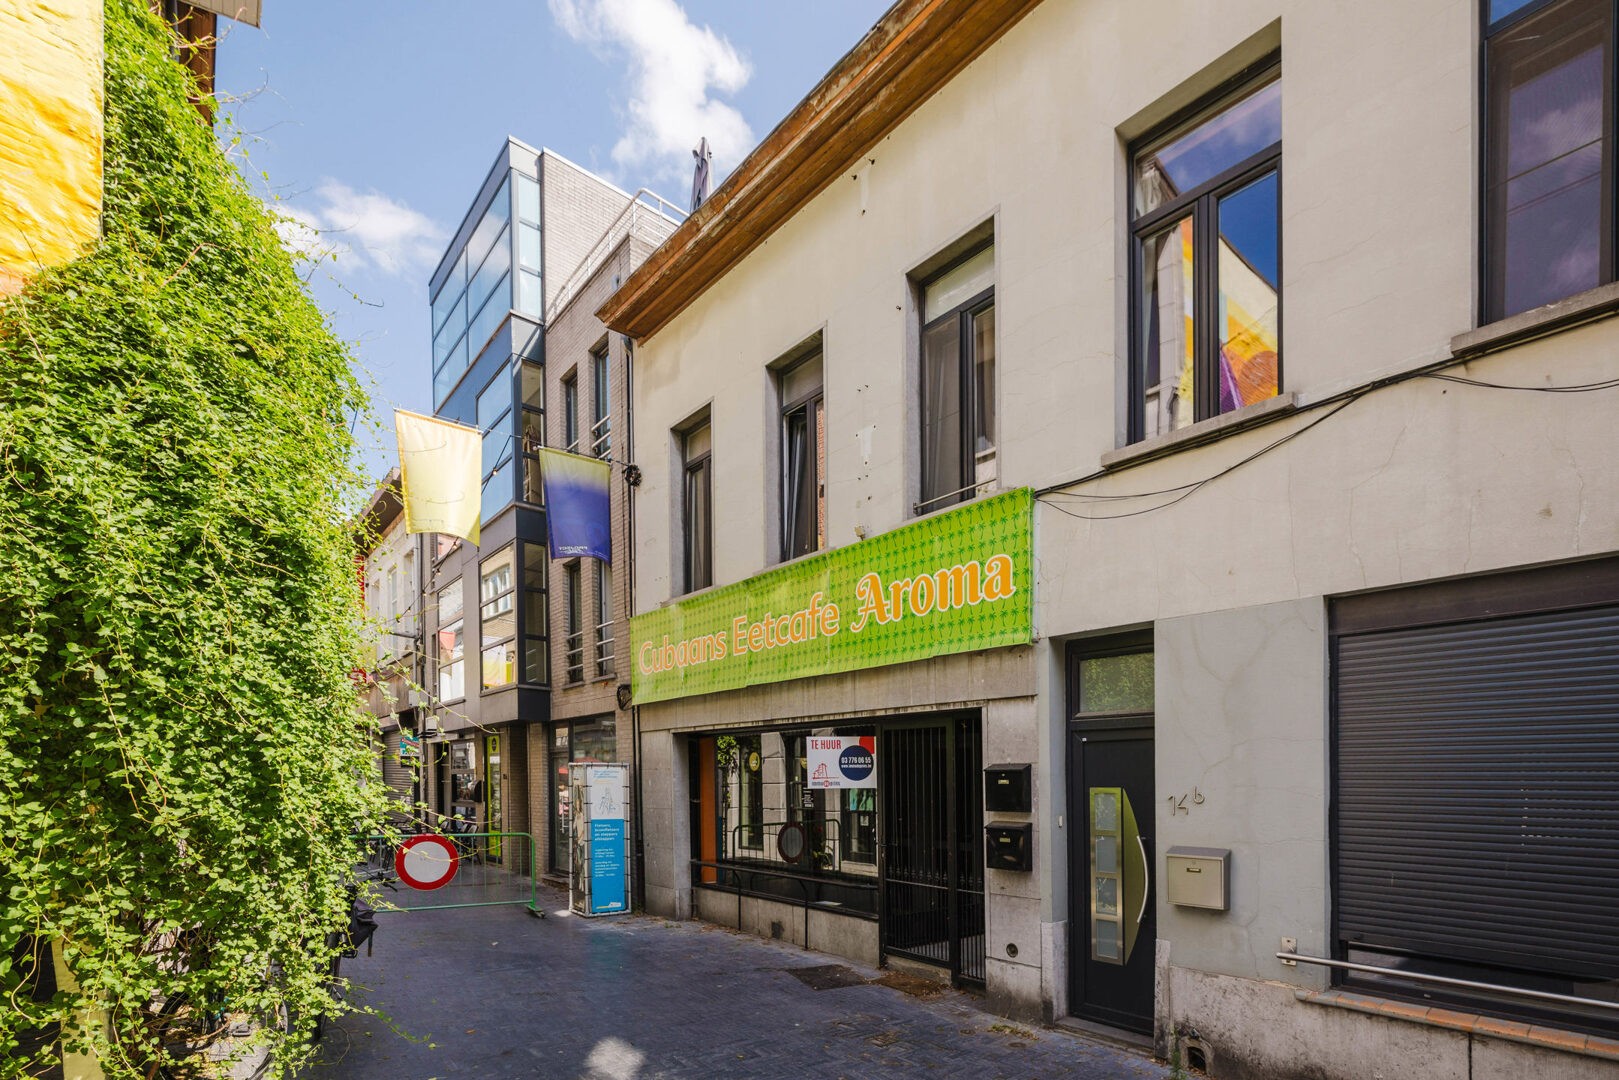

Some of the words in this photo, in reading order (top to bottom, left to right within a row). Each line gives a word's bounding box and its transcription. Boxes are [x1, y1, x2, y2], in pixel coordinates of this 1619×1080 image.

[639, 631, 727, 675] Cubaans
[732, 592, 840, 656] Eetcafe
[850, 554, 1016, 632] Aroma
[811, 740, 818, 750] TE
[820, 740, 842, 750] HUUR
